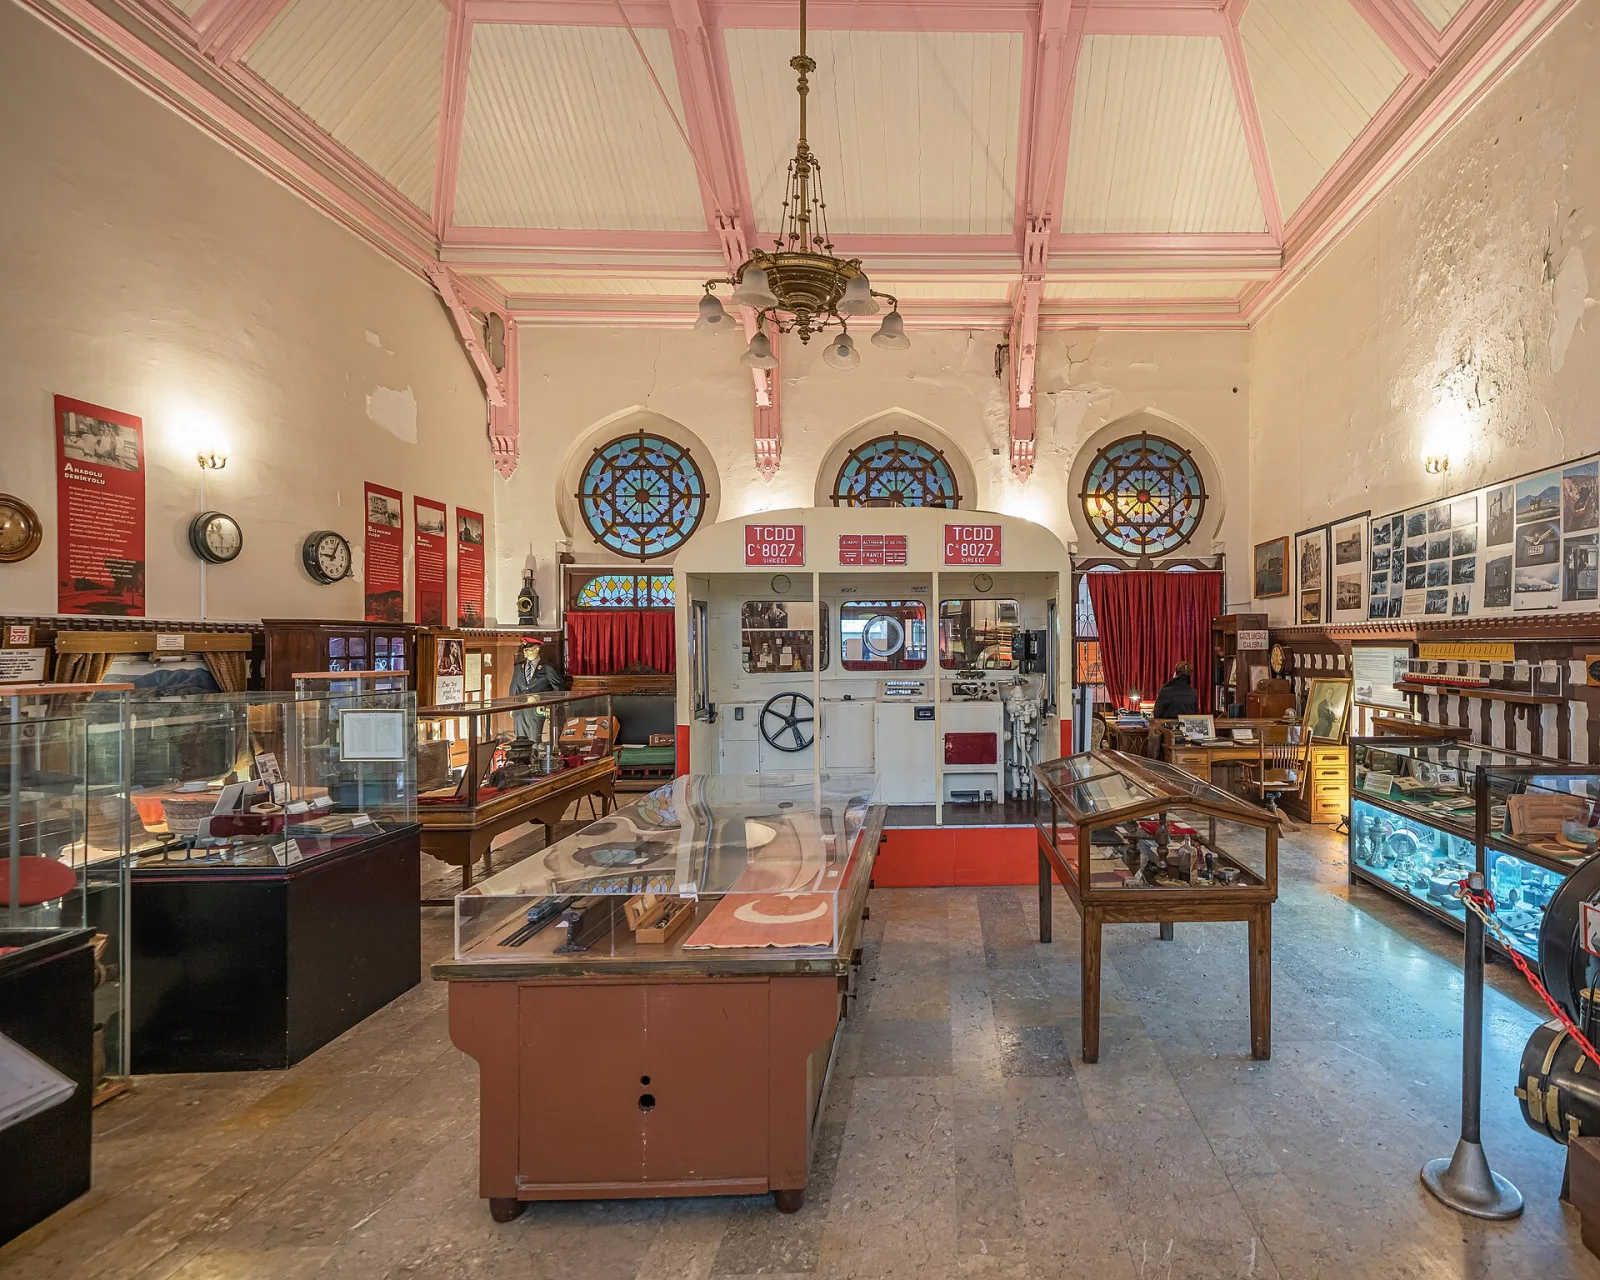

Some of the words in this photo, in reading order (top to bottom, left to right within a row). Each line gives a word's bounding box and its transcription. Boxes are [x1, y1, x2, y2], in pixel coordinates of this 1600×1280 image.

[64, 463, 103, 478] ANADOLU
[753, 527, 796, 541] TCDD
[952, 527, 994, 541] TCDD
[10, 634, 28, 642] 276
